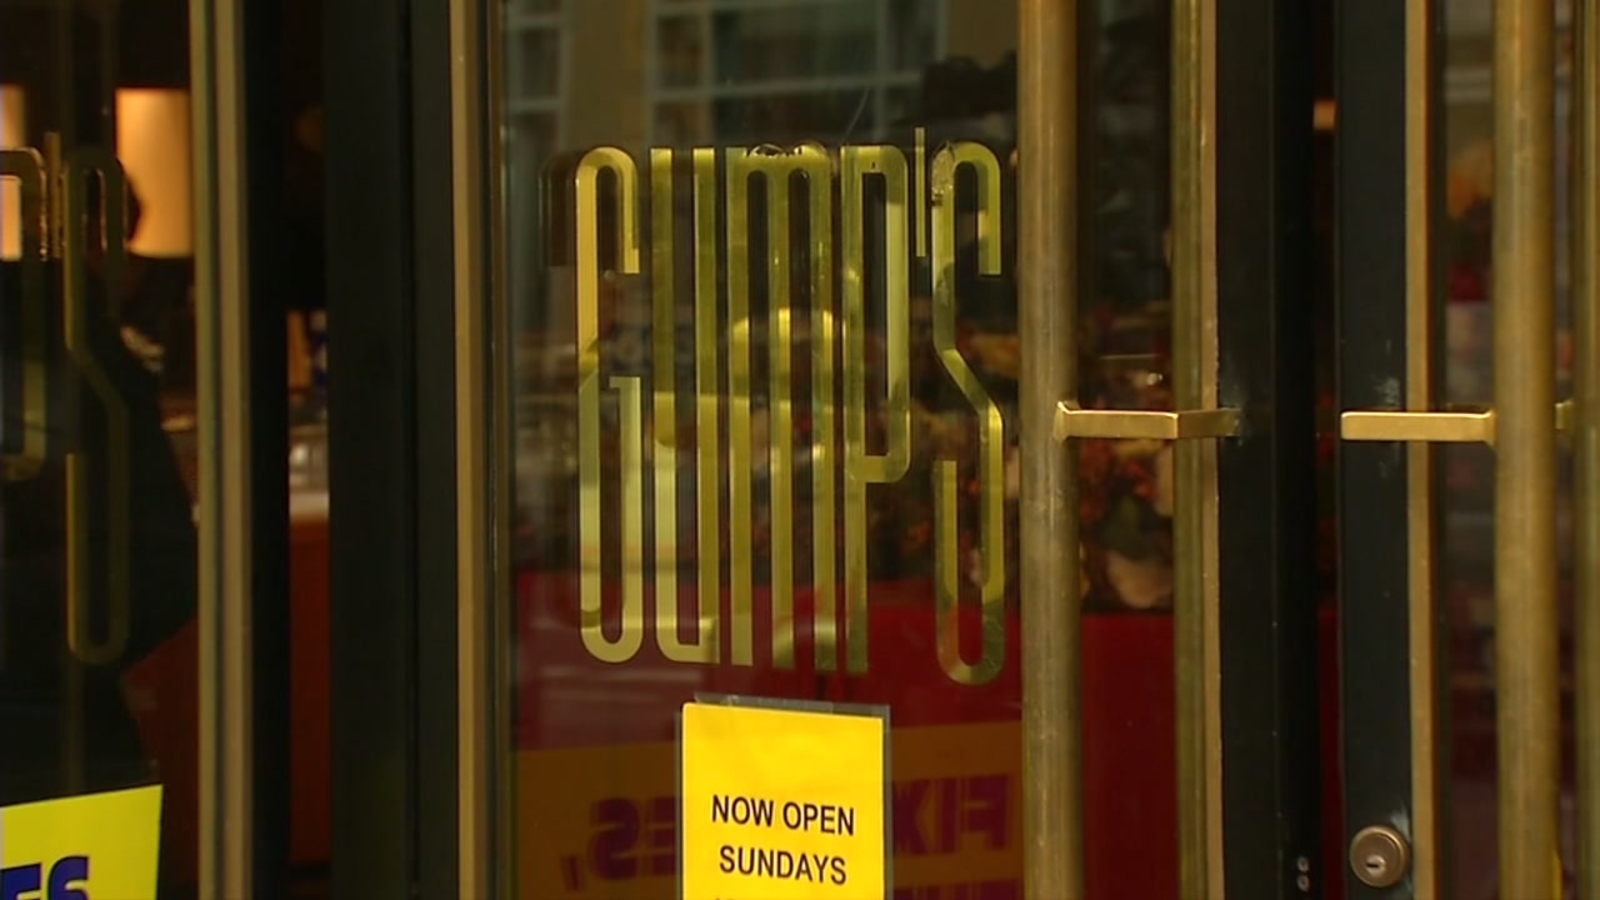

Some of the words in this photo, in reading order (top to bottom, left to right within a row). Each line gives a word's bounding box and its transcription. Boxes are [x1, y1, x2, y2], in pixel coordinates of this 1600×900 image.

[576, 127, 1005, 686] GUMP'S
[712, 794, 774, 827] NOW
[782, 802, 854, 836] OPEN
[719, 844, 847, 885] SUNDAYS
